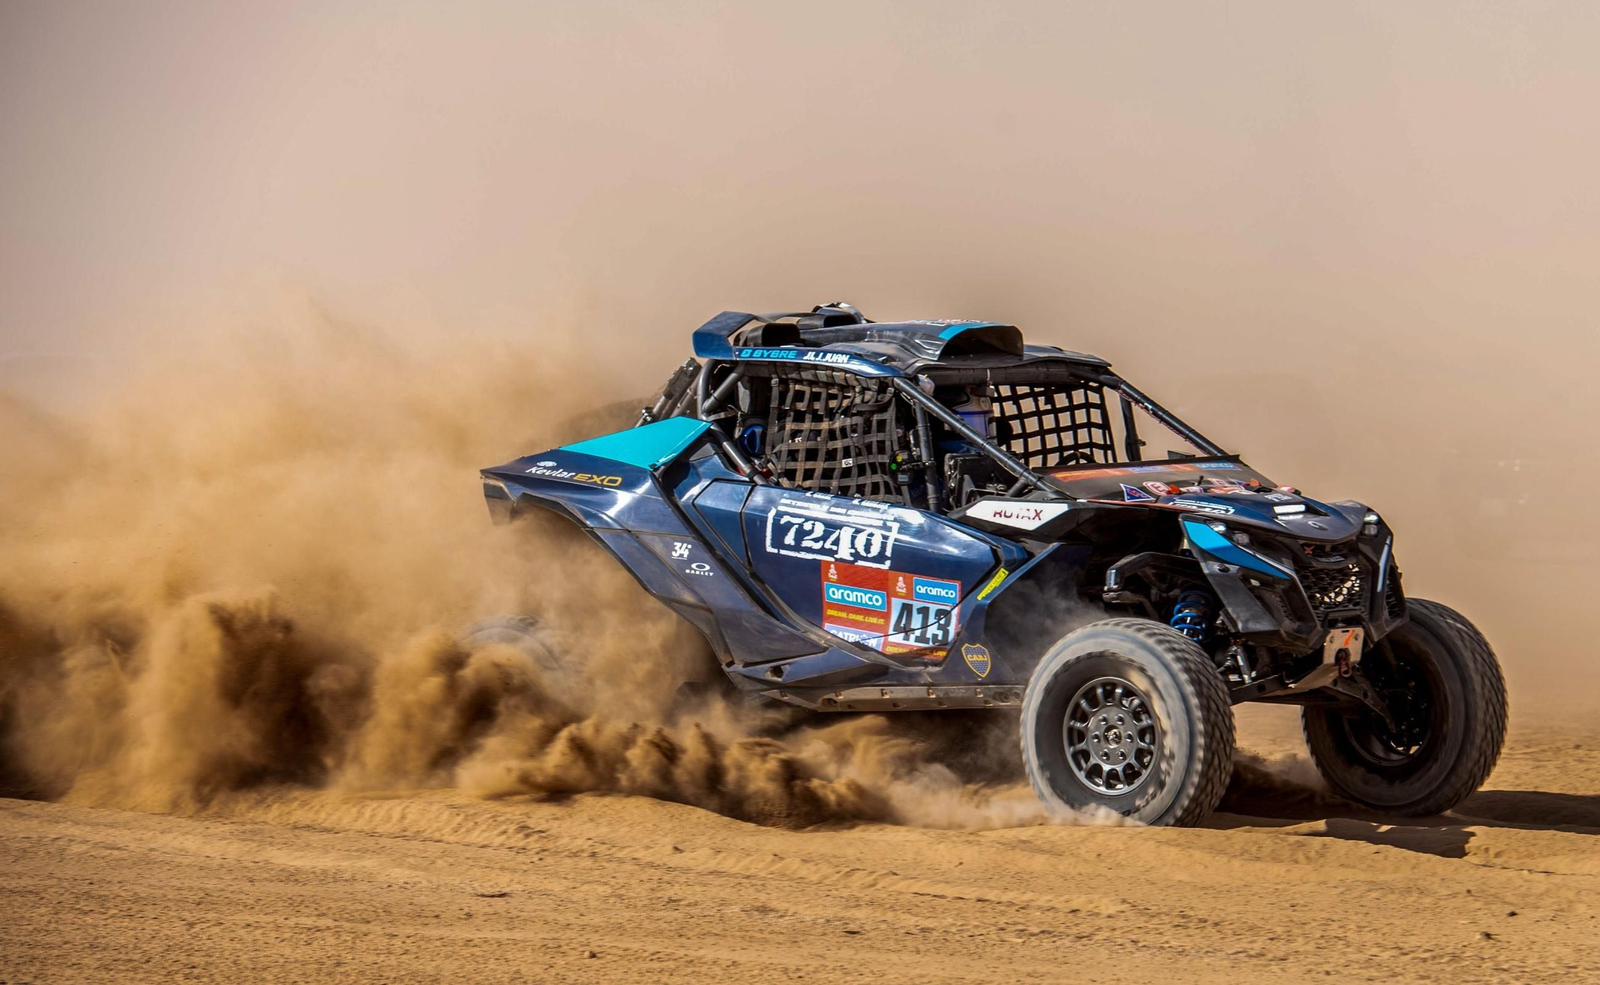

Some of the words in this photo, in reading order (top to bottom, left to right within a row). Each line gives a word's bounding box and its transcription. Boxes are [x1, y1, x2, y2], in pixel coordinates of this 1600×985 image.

[752, 349, 798, 359] BYBRE
[525, 466, 575, 479] Kevlar
[573, 473, 622, 487] EXO
[780, 515, 882, 561] 7240
[685, 569, 714, 577] OAKLEY
[829, 587, 882, 606] aramco
[916, 585, 956, 598] aramco
[893, 602, 952, 646] 413
